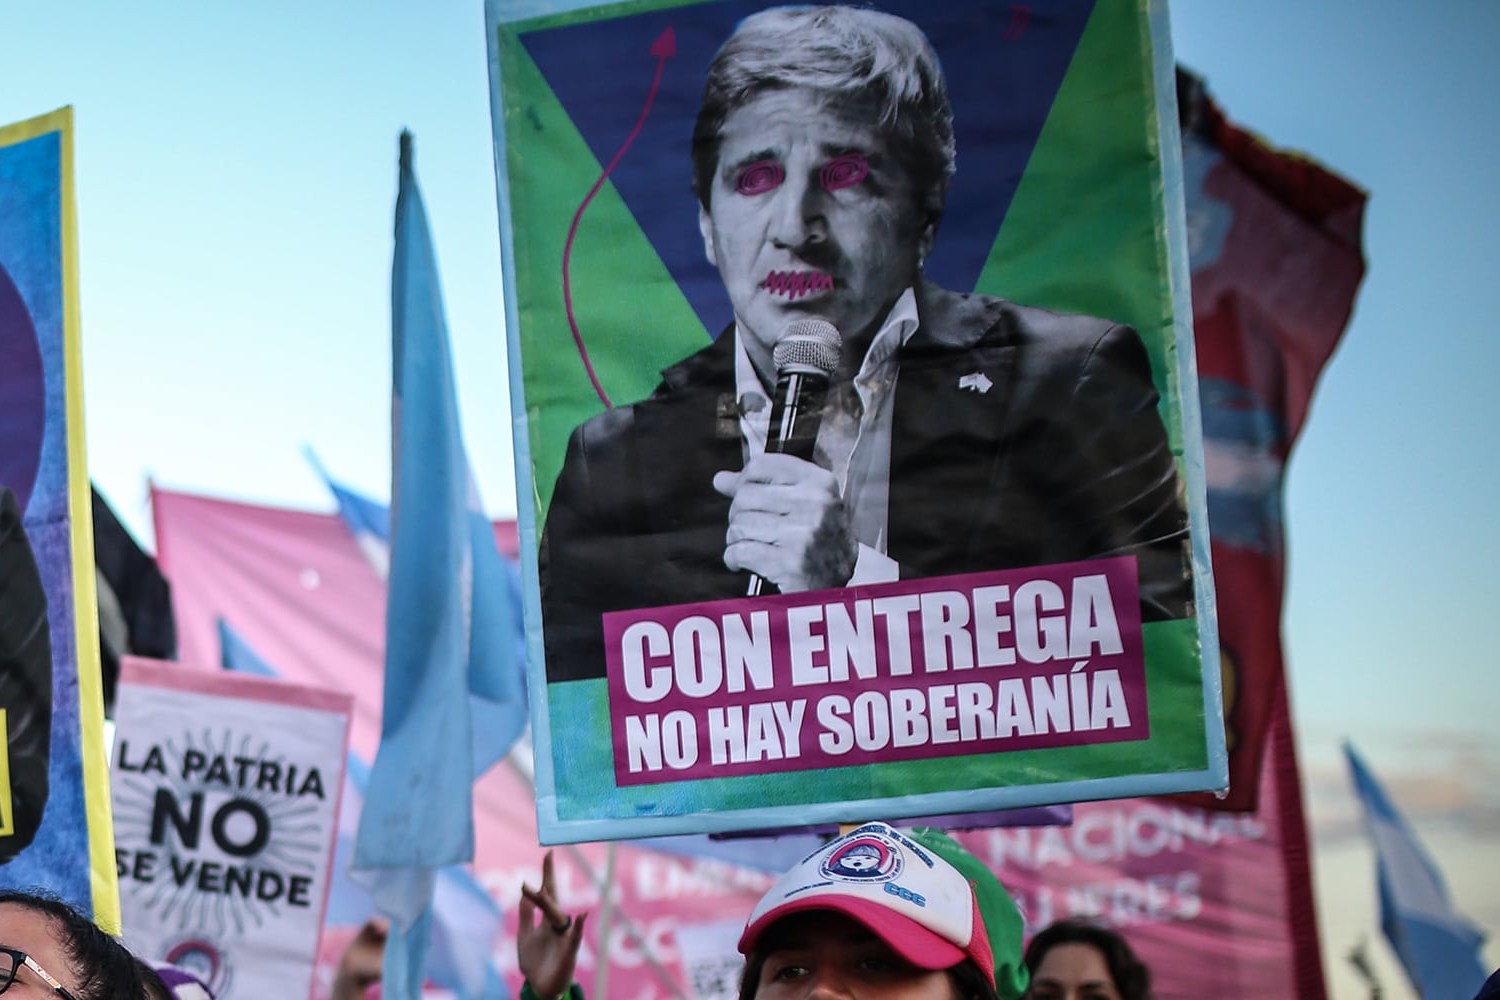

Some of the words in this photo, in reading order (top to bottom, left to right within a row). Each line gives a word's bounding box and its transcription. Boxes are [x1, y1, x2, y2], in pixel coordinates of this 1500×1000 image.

[621, 609, 774, 703] CON
[787, 573, 1125, 687] ENTREGA
[625, 710, 699, 773] NO
[708, 699, 807, 766] HAY
[816, 661, 1132, 756] SOBERANÍA
[118, 740, 167, 775] LA
[182, 747, 326, 801] PATRIA
[150, 786, 271, 858] NO
[115, 847, 157, 883] SE
[170, 852, 313, 908] VENDE
